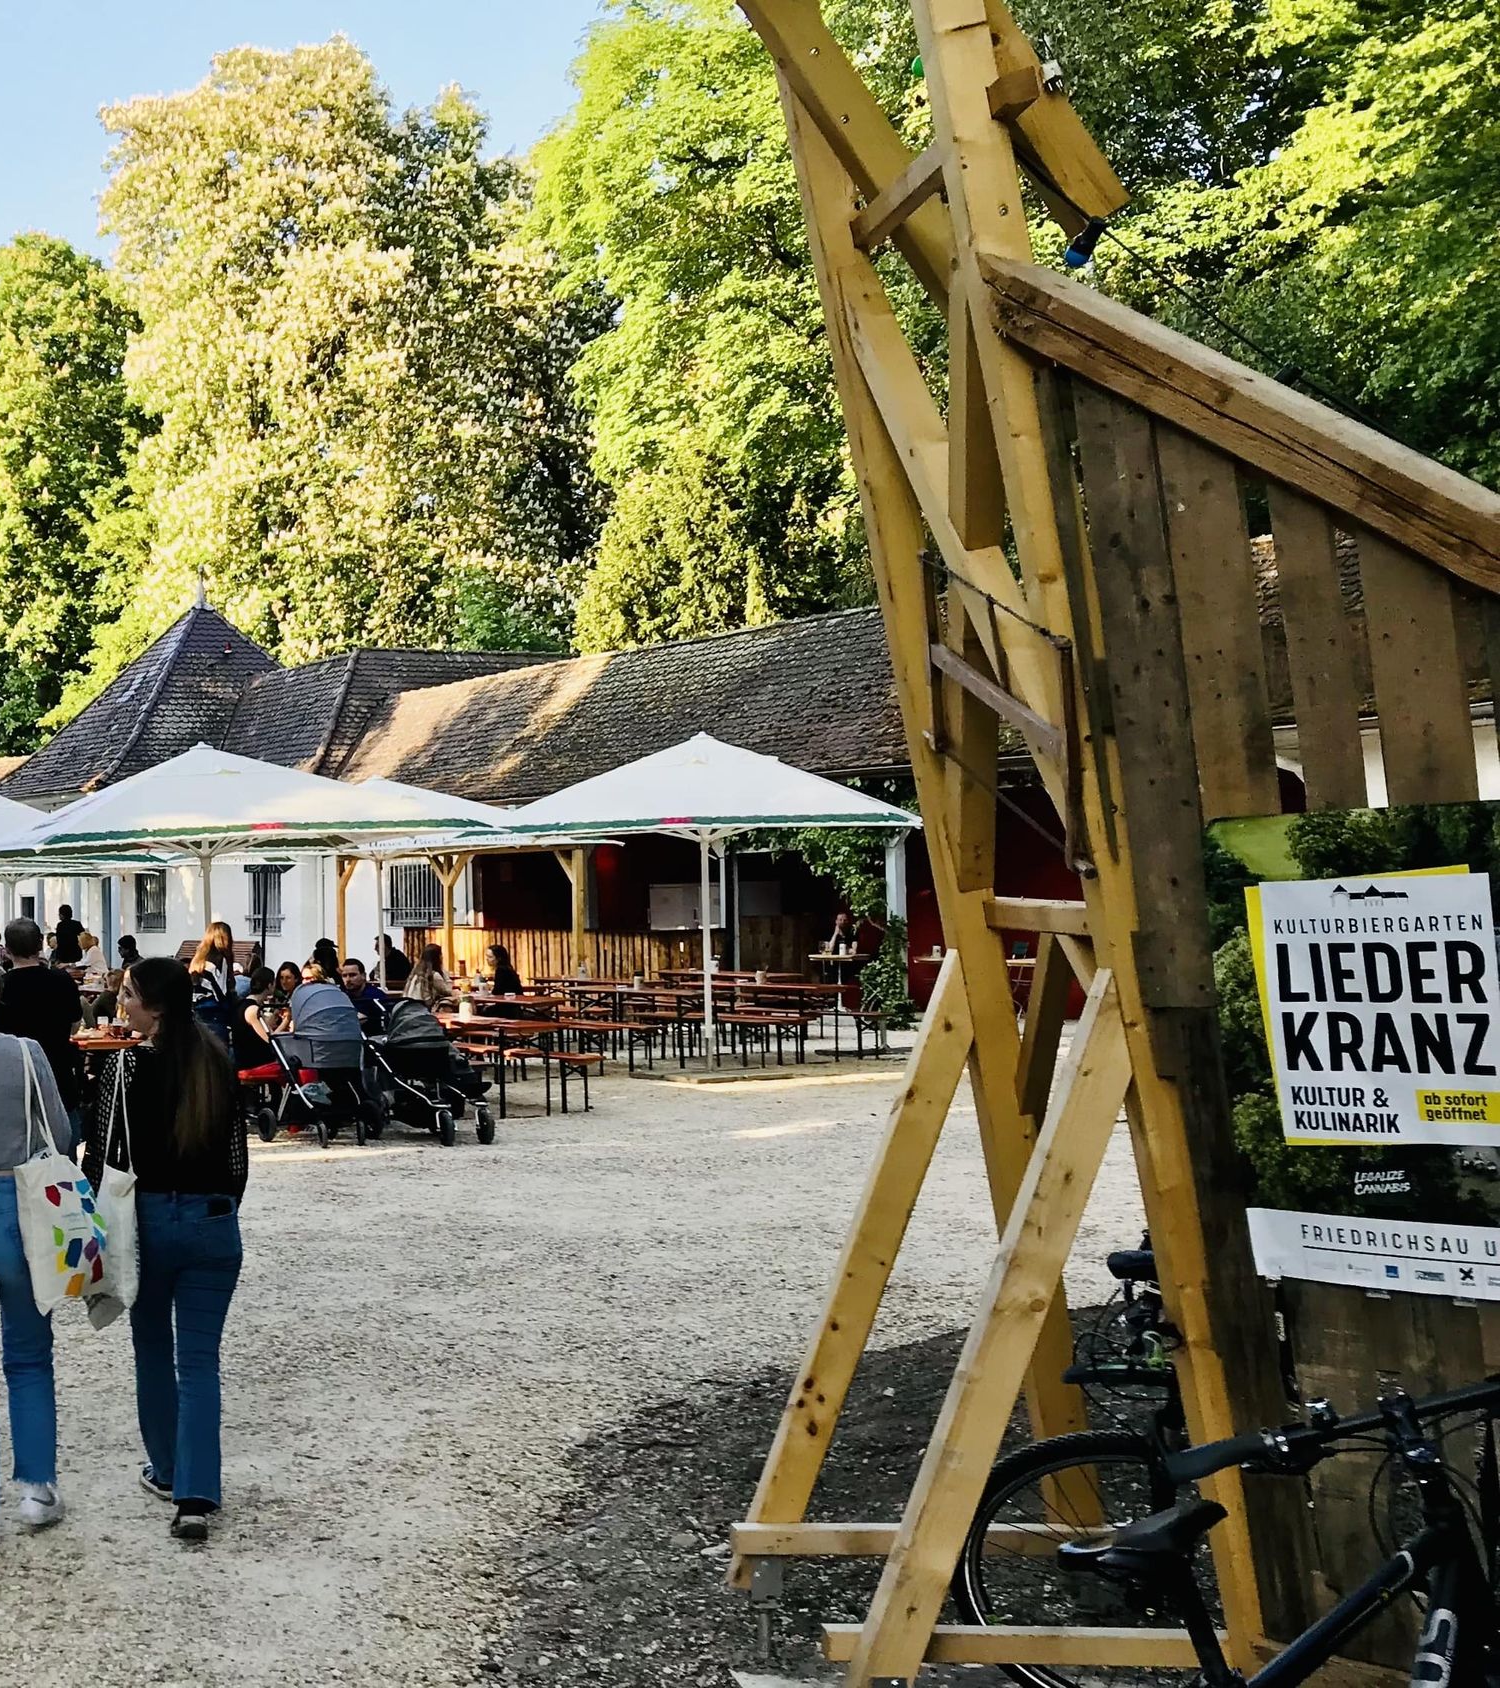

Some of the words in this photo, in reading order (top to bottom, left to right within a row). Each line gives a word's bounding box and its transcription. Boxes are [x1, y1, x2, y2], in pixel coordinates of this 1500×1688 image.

[1274, 914, 1484, 935] KULTURBIERGARTEN
[1276, 940, 1489, 1004] LIEDER
[1281, 1011, 1497, 1077] KRANZ
[1291, 1085, 1366, 1107] KULTUR
[1372, 1087, 1390, 1108] &
[1423, 1092, 1442, 1106] ab
[1444, 1093, 1488, 1107] sofort
[1294, 1109, 1401, 1134] KULINARIK
[1426, 1106, 1488, 1122] geöffnet
[1354, 1170, 1406, 1184] LEGALIZE
[1354, 1182, 1411, 1196] CANNABIS
[1301, 1223, 1469, 1255] FRIEDRICHSAU
